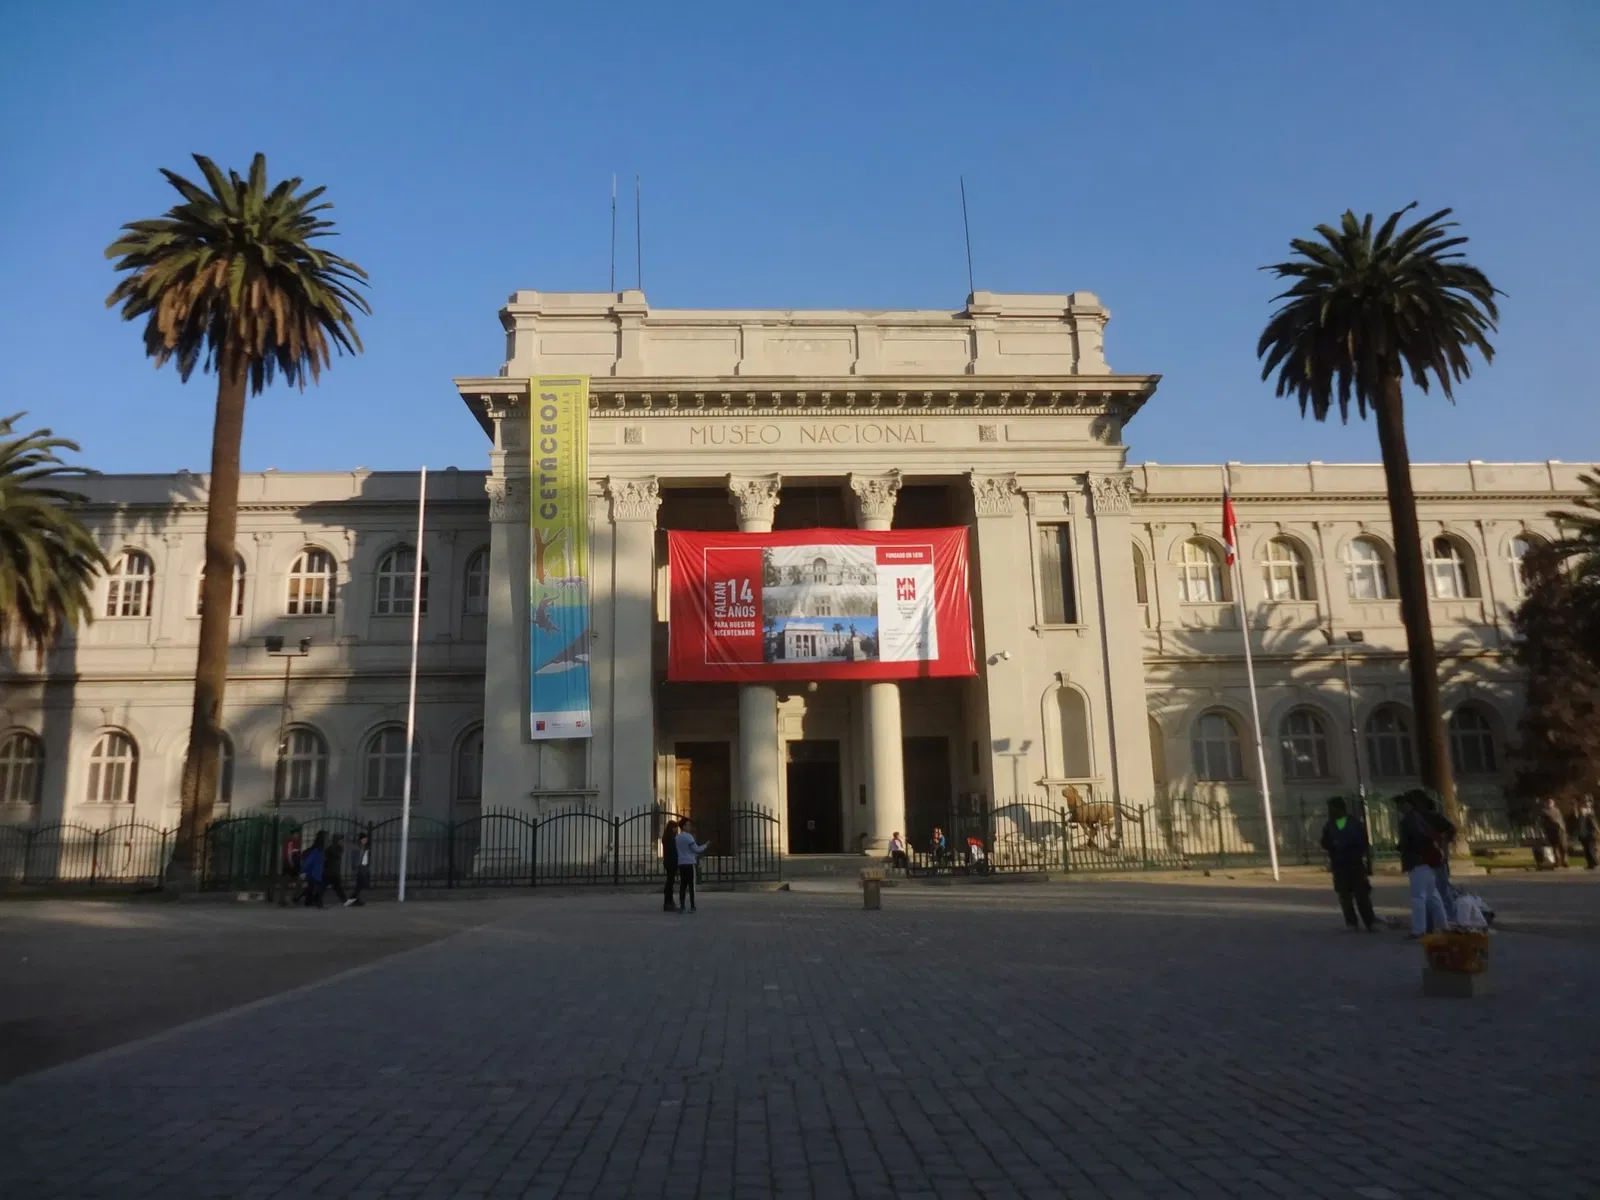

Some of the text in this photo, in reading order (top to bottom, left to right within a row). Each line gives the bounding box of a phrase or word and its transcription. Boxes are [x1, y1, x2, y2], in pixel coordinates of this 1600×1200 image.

[689, 423, 936, 445] MUSEO NACIONAL
[536, 393, 558, 520] CETÁCEOS
[714, 582, 726, 617] FALTAN
[728, 579, 753, 603] 14
[728, 602, 756, 618] AÑOS
